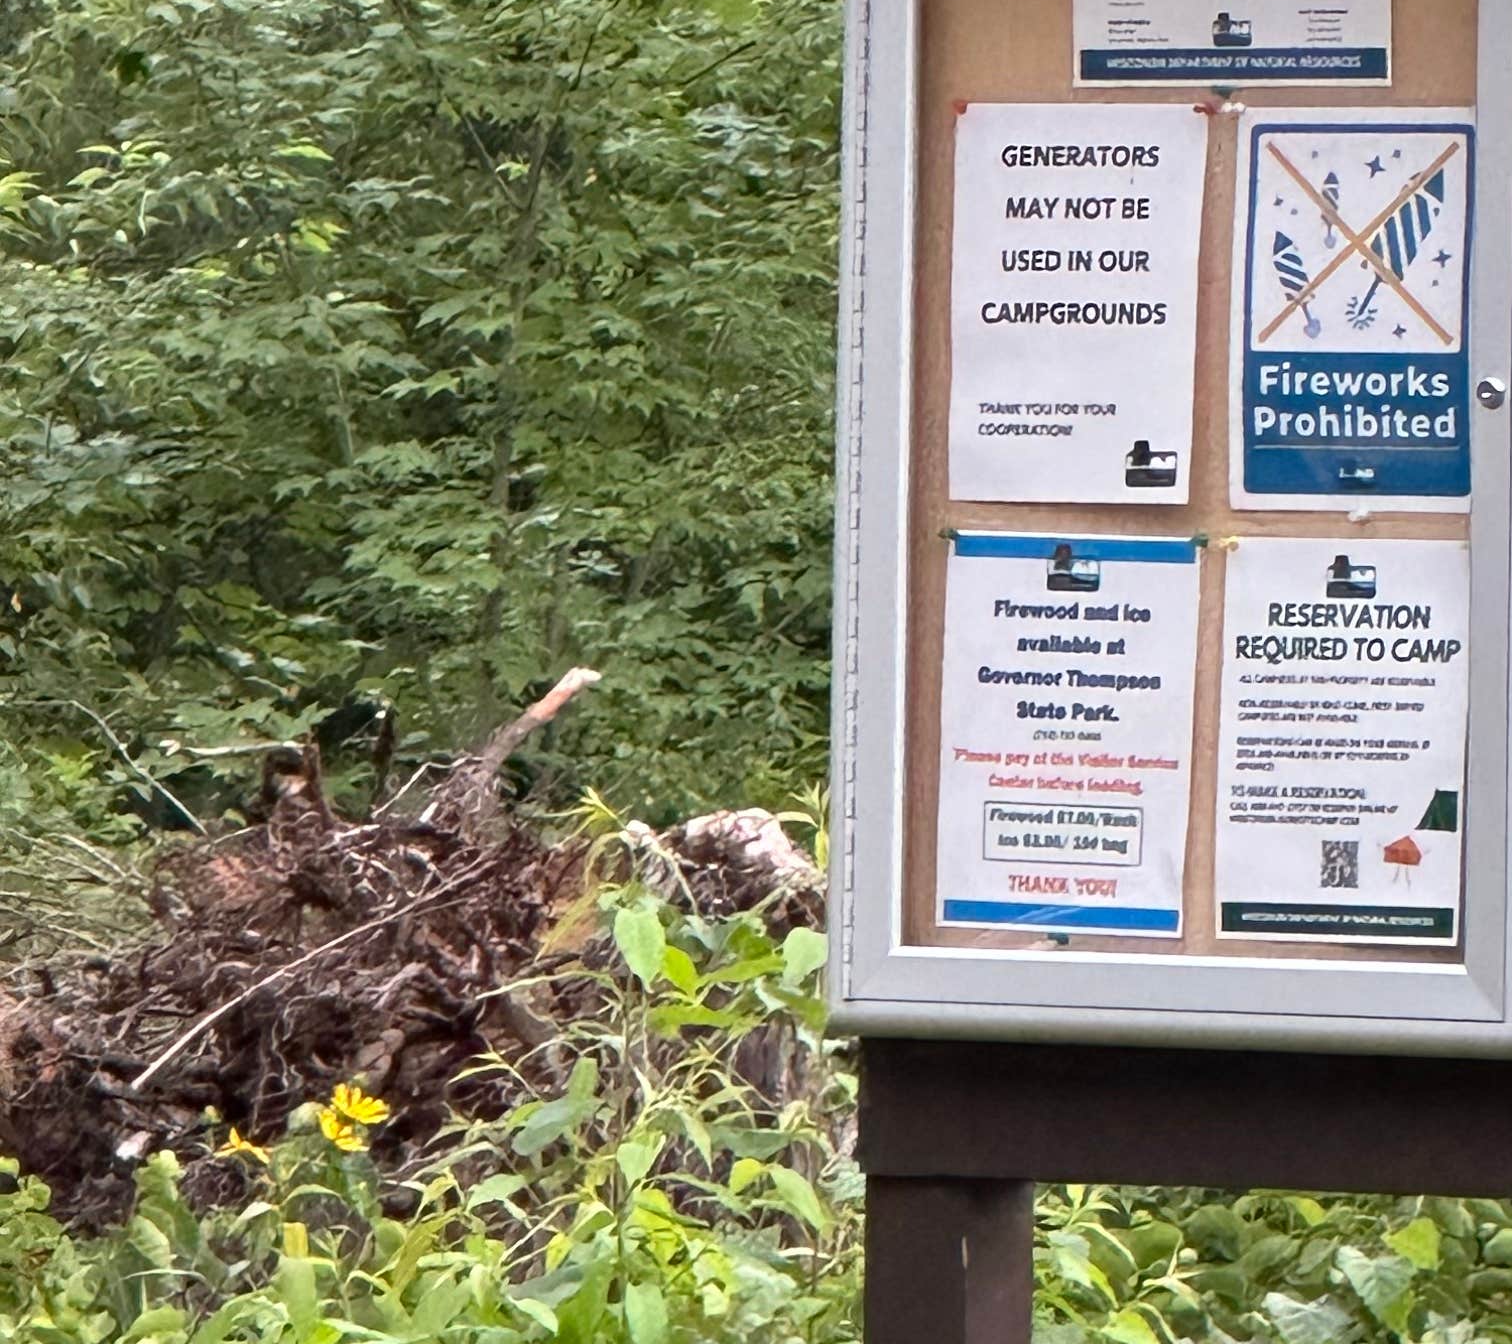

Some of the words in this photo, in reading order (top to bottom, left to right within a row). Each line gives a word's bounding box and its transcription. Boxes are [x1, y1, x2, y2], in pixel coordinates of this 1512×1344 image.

[1001, 144, 1160, 168] GENERATORS
[1005, 197, 1059, 220] MAY
[1064, 197, 1117, 220] NOT
[1121, 198, 1150, 220] BE
[1001, 250, 1060, 273] USED
[1068, 250, 1092, 272] IN
[1098, 250, 1151, 273] OUR
[981, 301, 1168, 326] CAMPGROUNDS
[1259, 362, 1450, 397] Fireworks
[1055, 403, 1079, 416] FOR
[1083, 403, 1117, 416] YOUR
[1254, 405, 1457, 440] Prohibited
[994, 599, 1079, 620] Firewood
[1268, 603, 1431, 629] RESERVATION
[1017, 635, 1101, 655] available
[1235, 635, 1348, 665] REQUIRED
[1353, 638, 1385, 662] TO
[1391, 638, 1462, 663] CAMP
[978, 665, 1062, 686] Governor
[1066, 669, 1161, 691] Thompson
[1016, 700, 1067, 720] State
[1071, 702, 1120, 722] Park.
[1008, 874, 1069, 894] THANK
